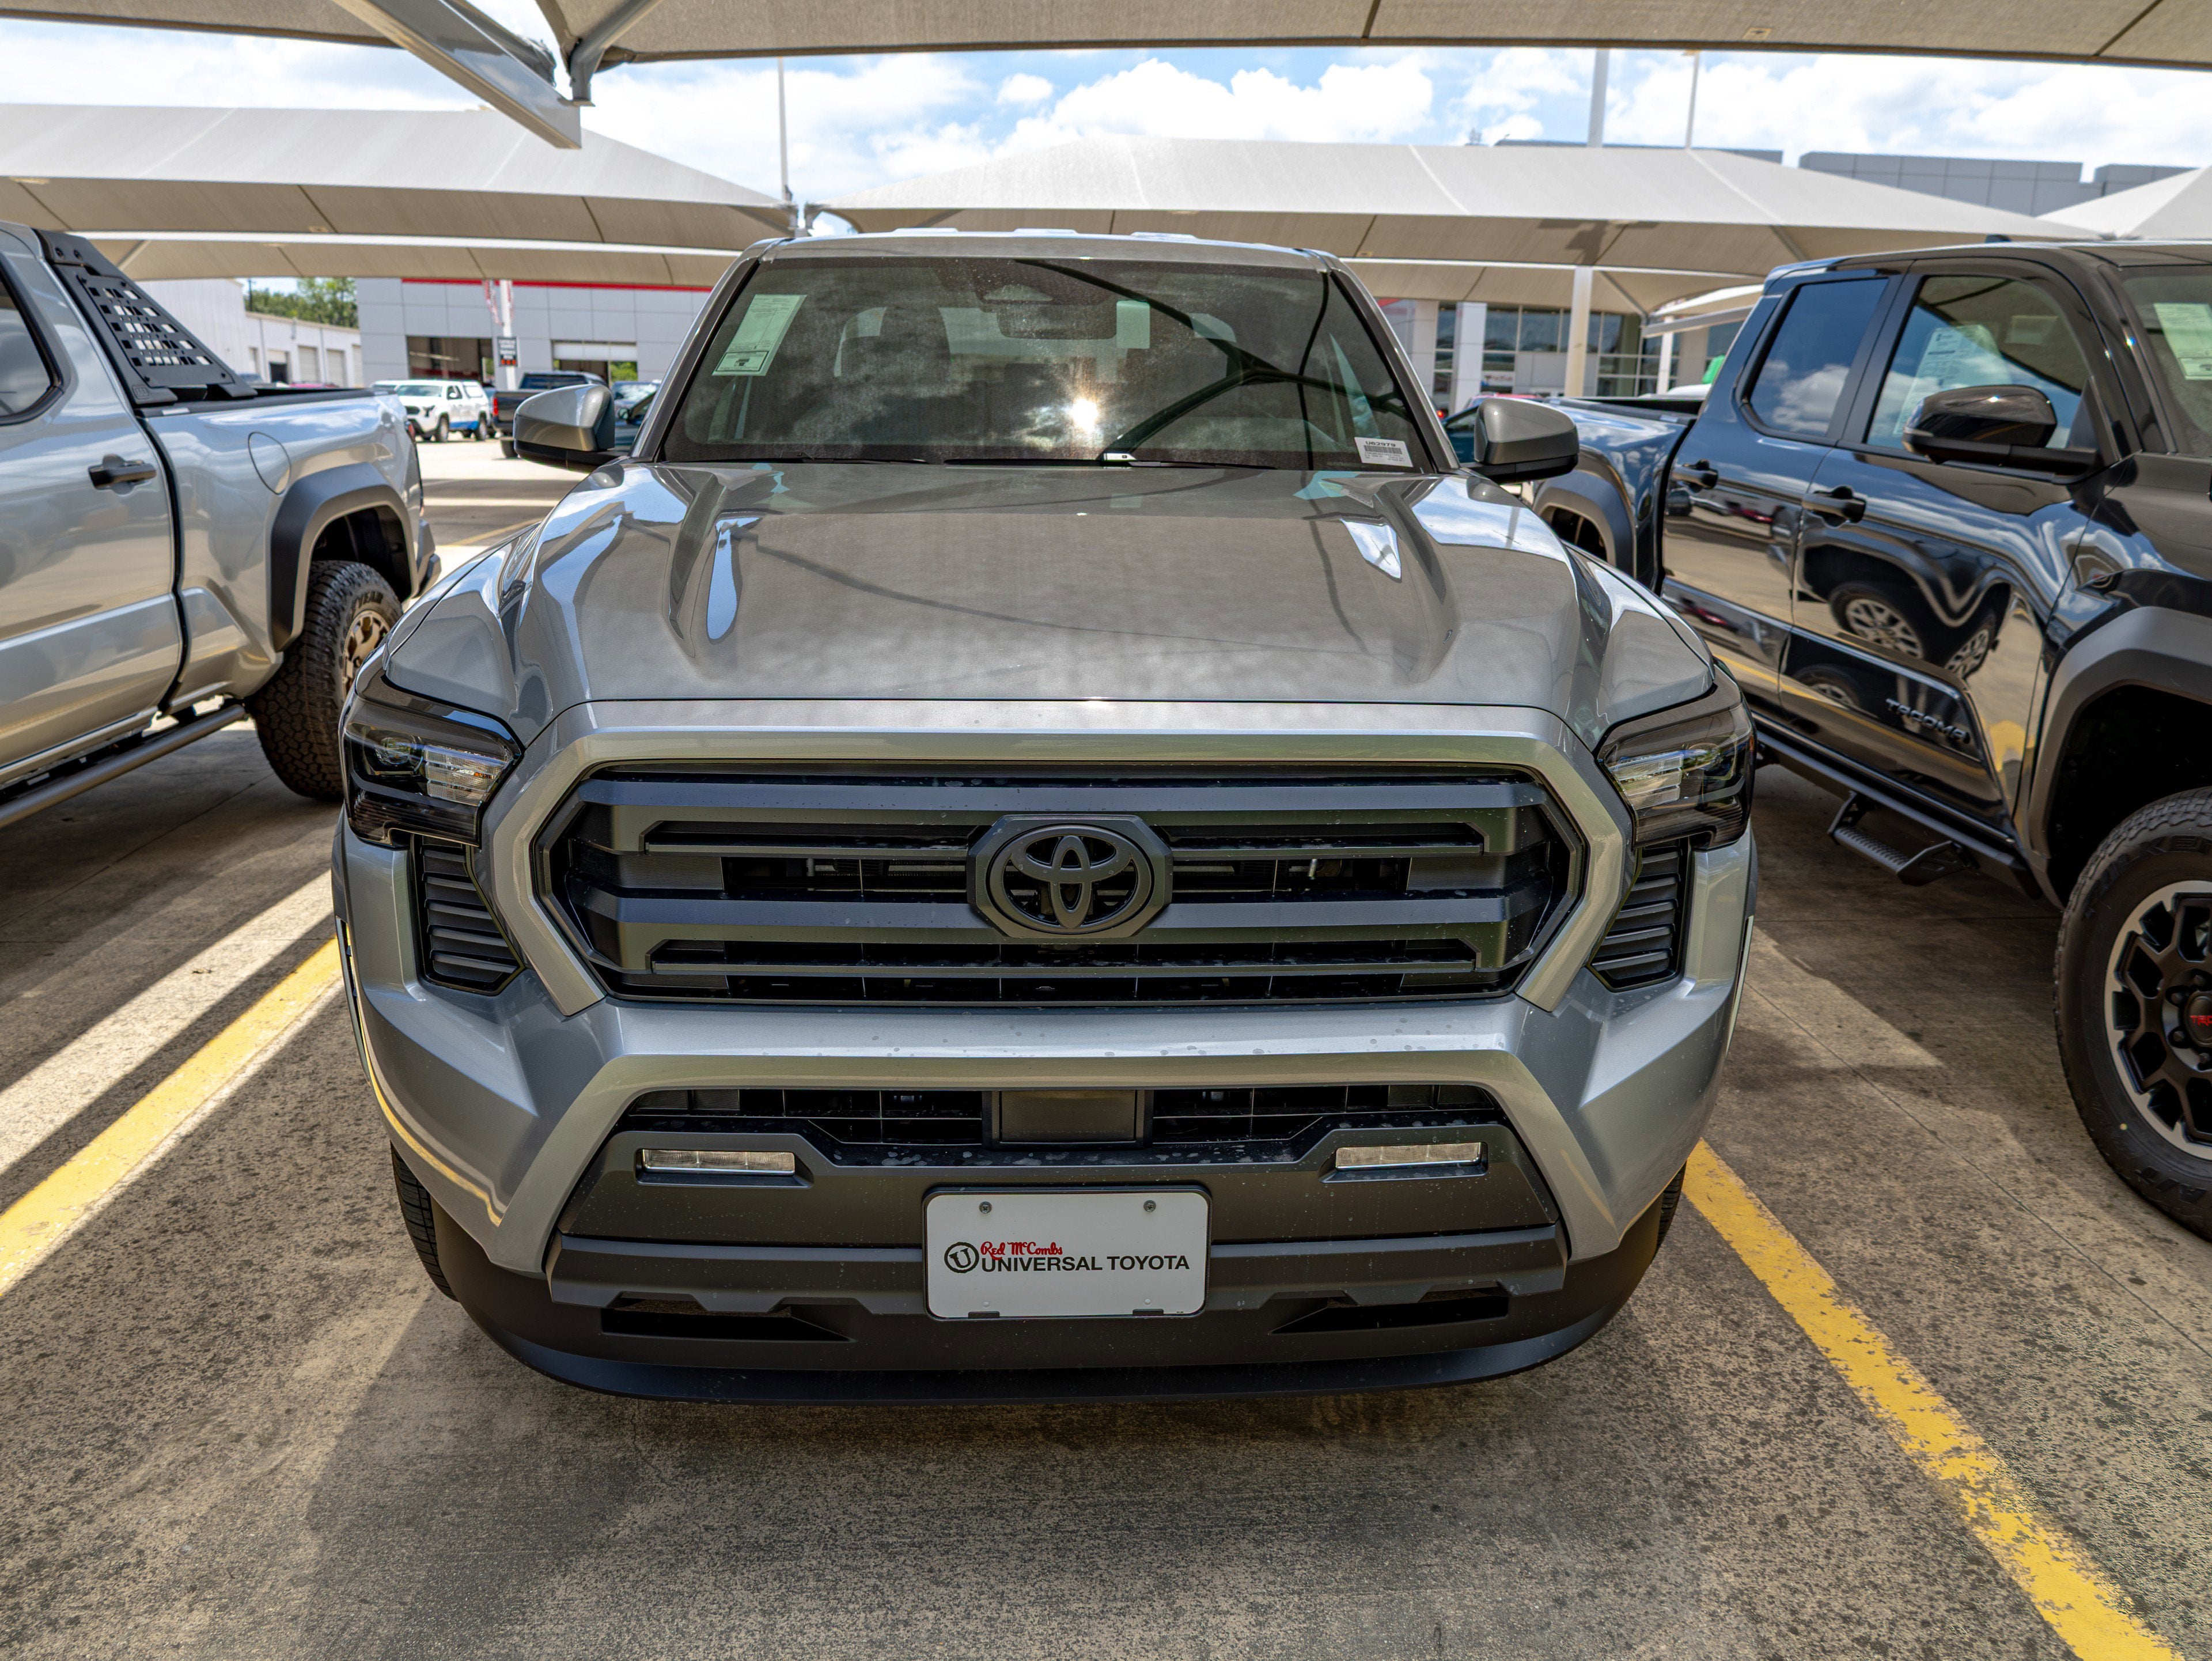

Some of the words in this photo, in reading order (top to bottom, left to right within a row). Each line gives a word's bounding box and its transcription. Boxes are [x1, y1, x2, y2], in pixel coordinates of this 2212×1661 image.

[1885, 698, 1969, 741] TACOMA
[980, 1241, 1006, 1260] Red
[1007, 1242, 1063, 1255] McCombs
[982, 1256, 1103, 1272] UNIVERSAL
[1107, 1255, 1190, 1270] TOYOTA
